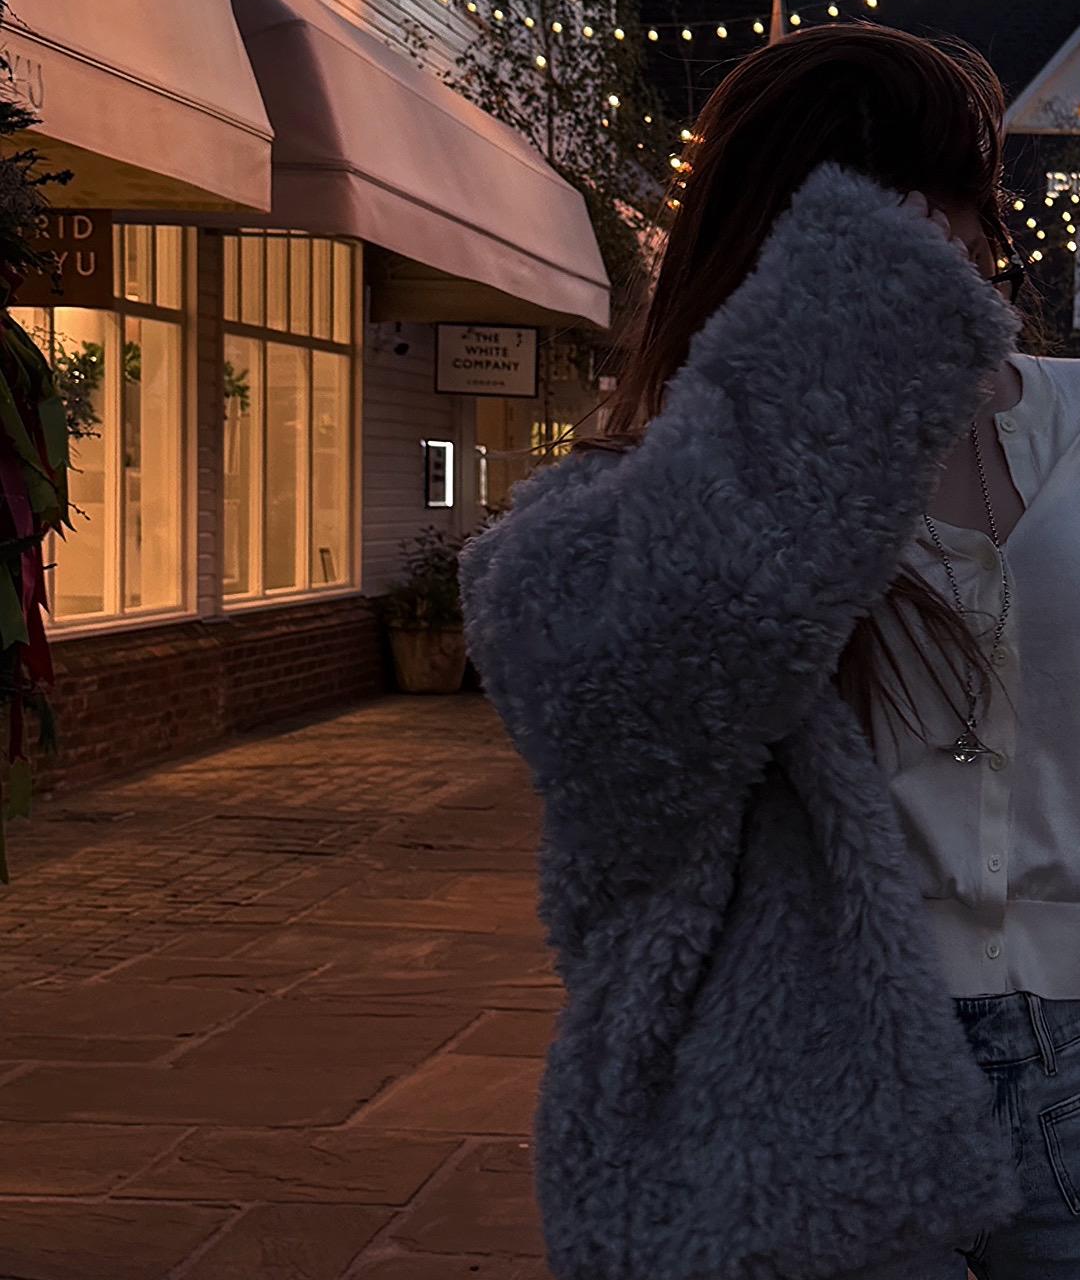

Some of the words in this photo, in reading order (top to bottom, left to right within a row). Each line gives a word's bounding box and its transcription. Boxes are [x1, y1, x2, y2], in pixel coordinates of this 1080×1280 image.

[475, 332, 498, 343] THE
[465, 345, 507, 357] WHITE
[452, 357, 519, 371] COMPANY
